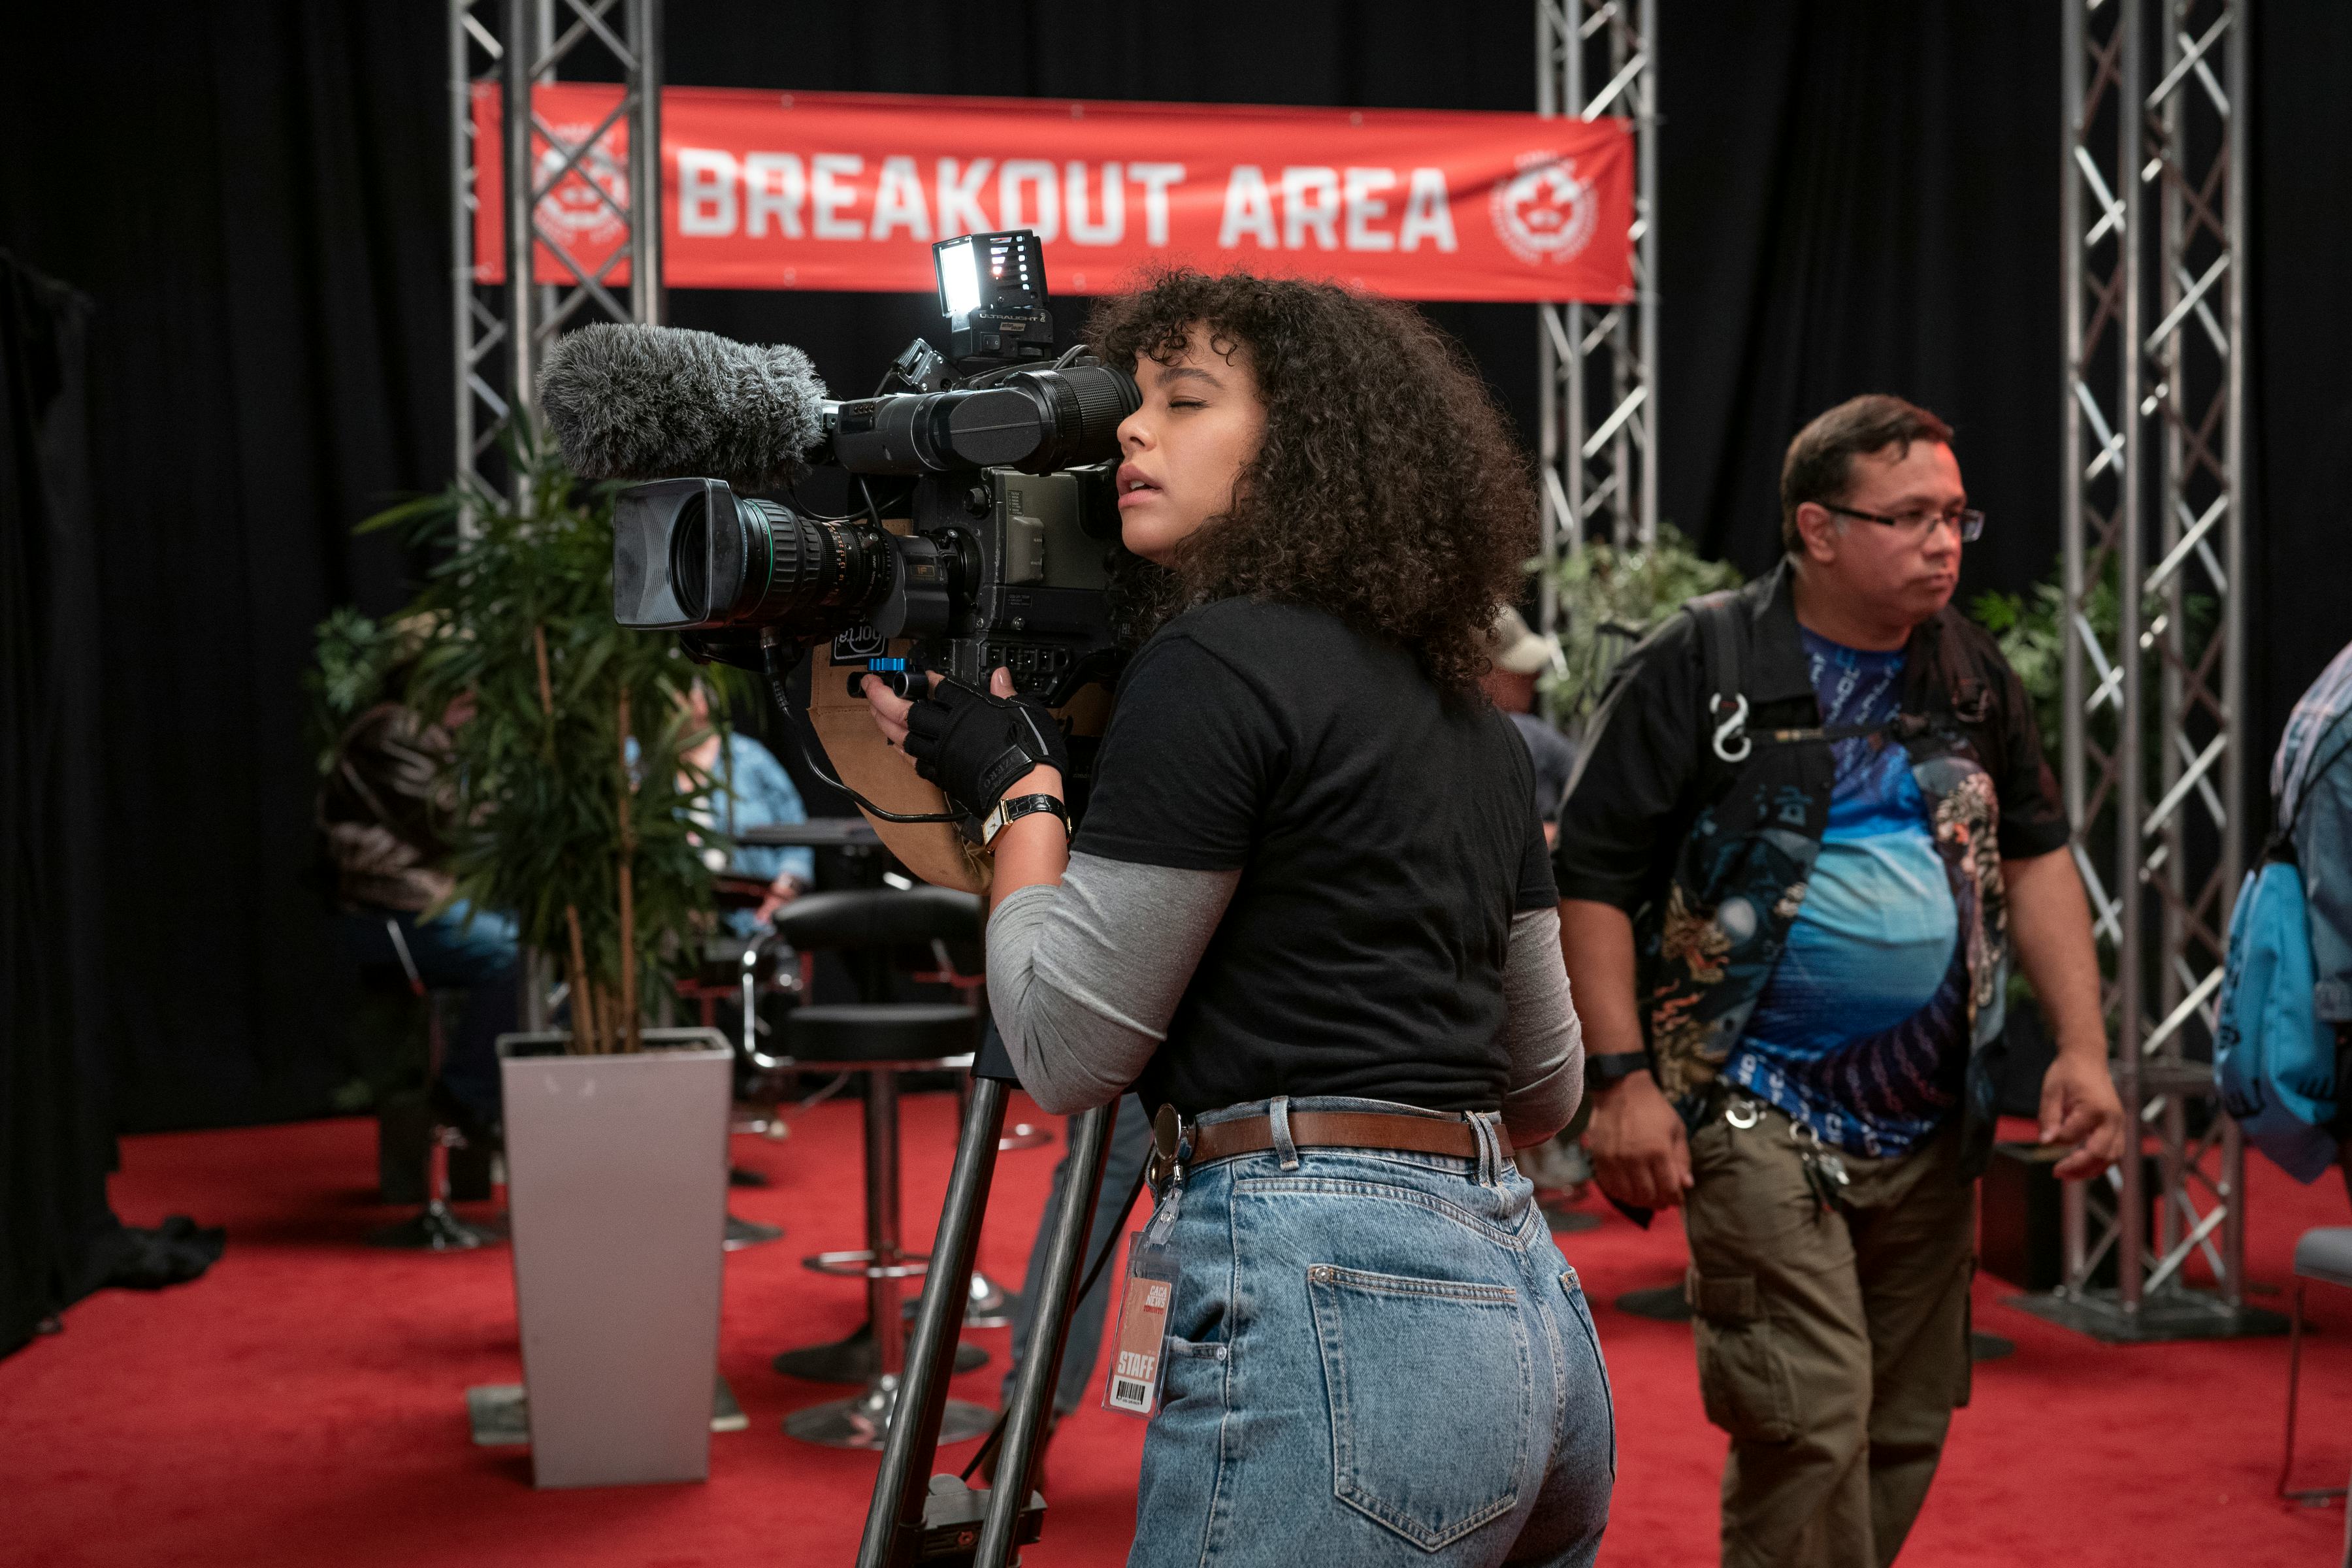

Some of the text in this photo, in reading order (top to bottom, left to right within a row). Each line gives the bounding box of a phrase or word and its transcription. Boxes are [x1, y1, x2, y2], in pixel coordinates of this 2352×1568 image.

[676, 146, 1186, 248] BREAKOUT
[1217, 163, 1459, 253] AREA
[979, 312, 1046, 323] ULTRALIGHT 2
[1145, 1294, 1166, 1308] NEWS
[1117, 1350, 1155, 1380] STAFF
